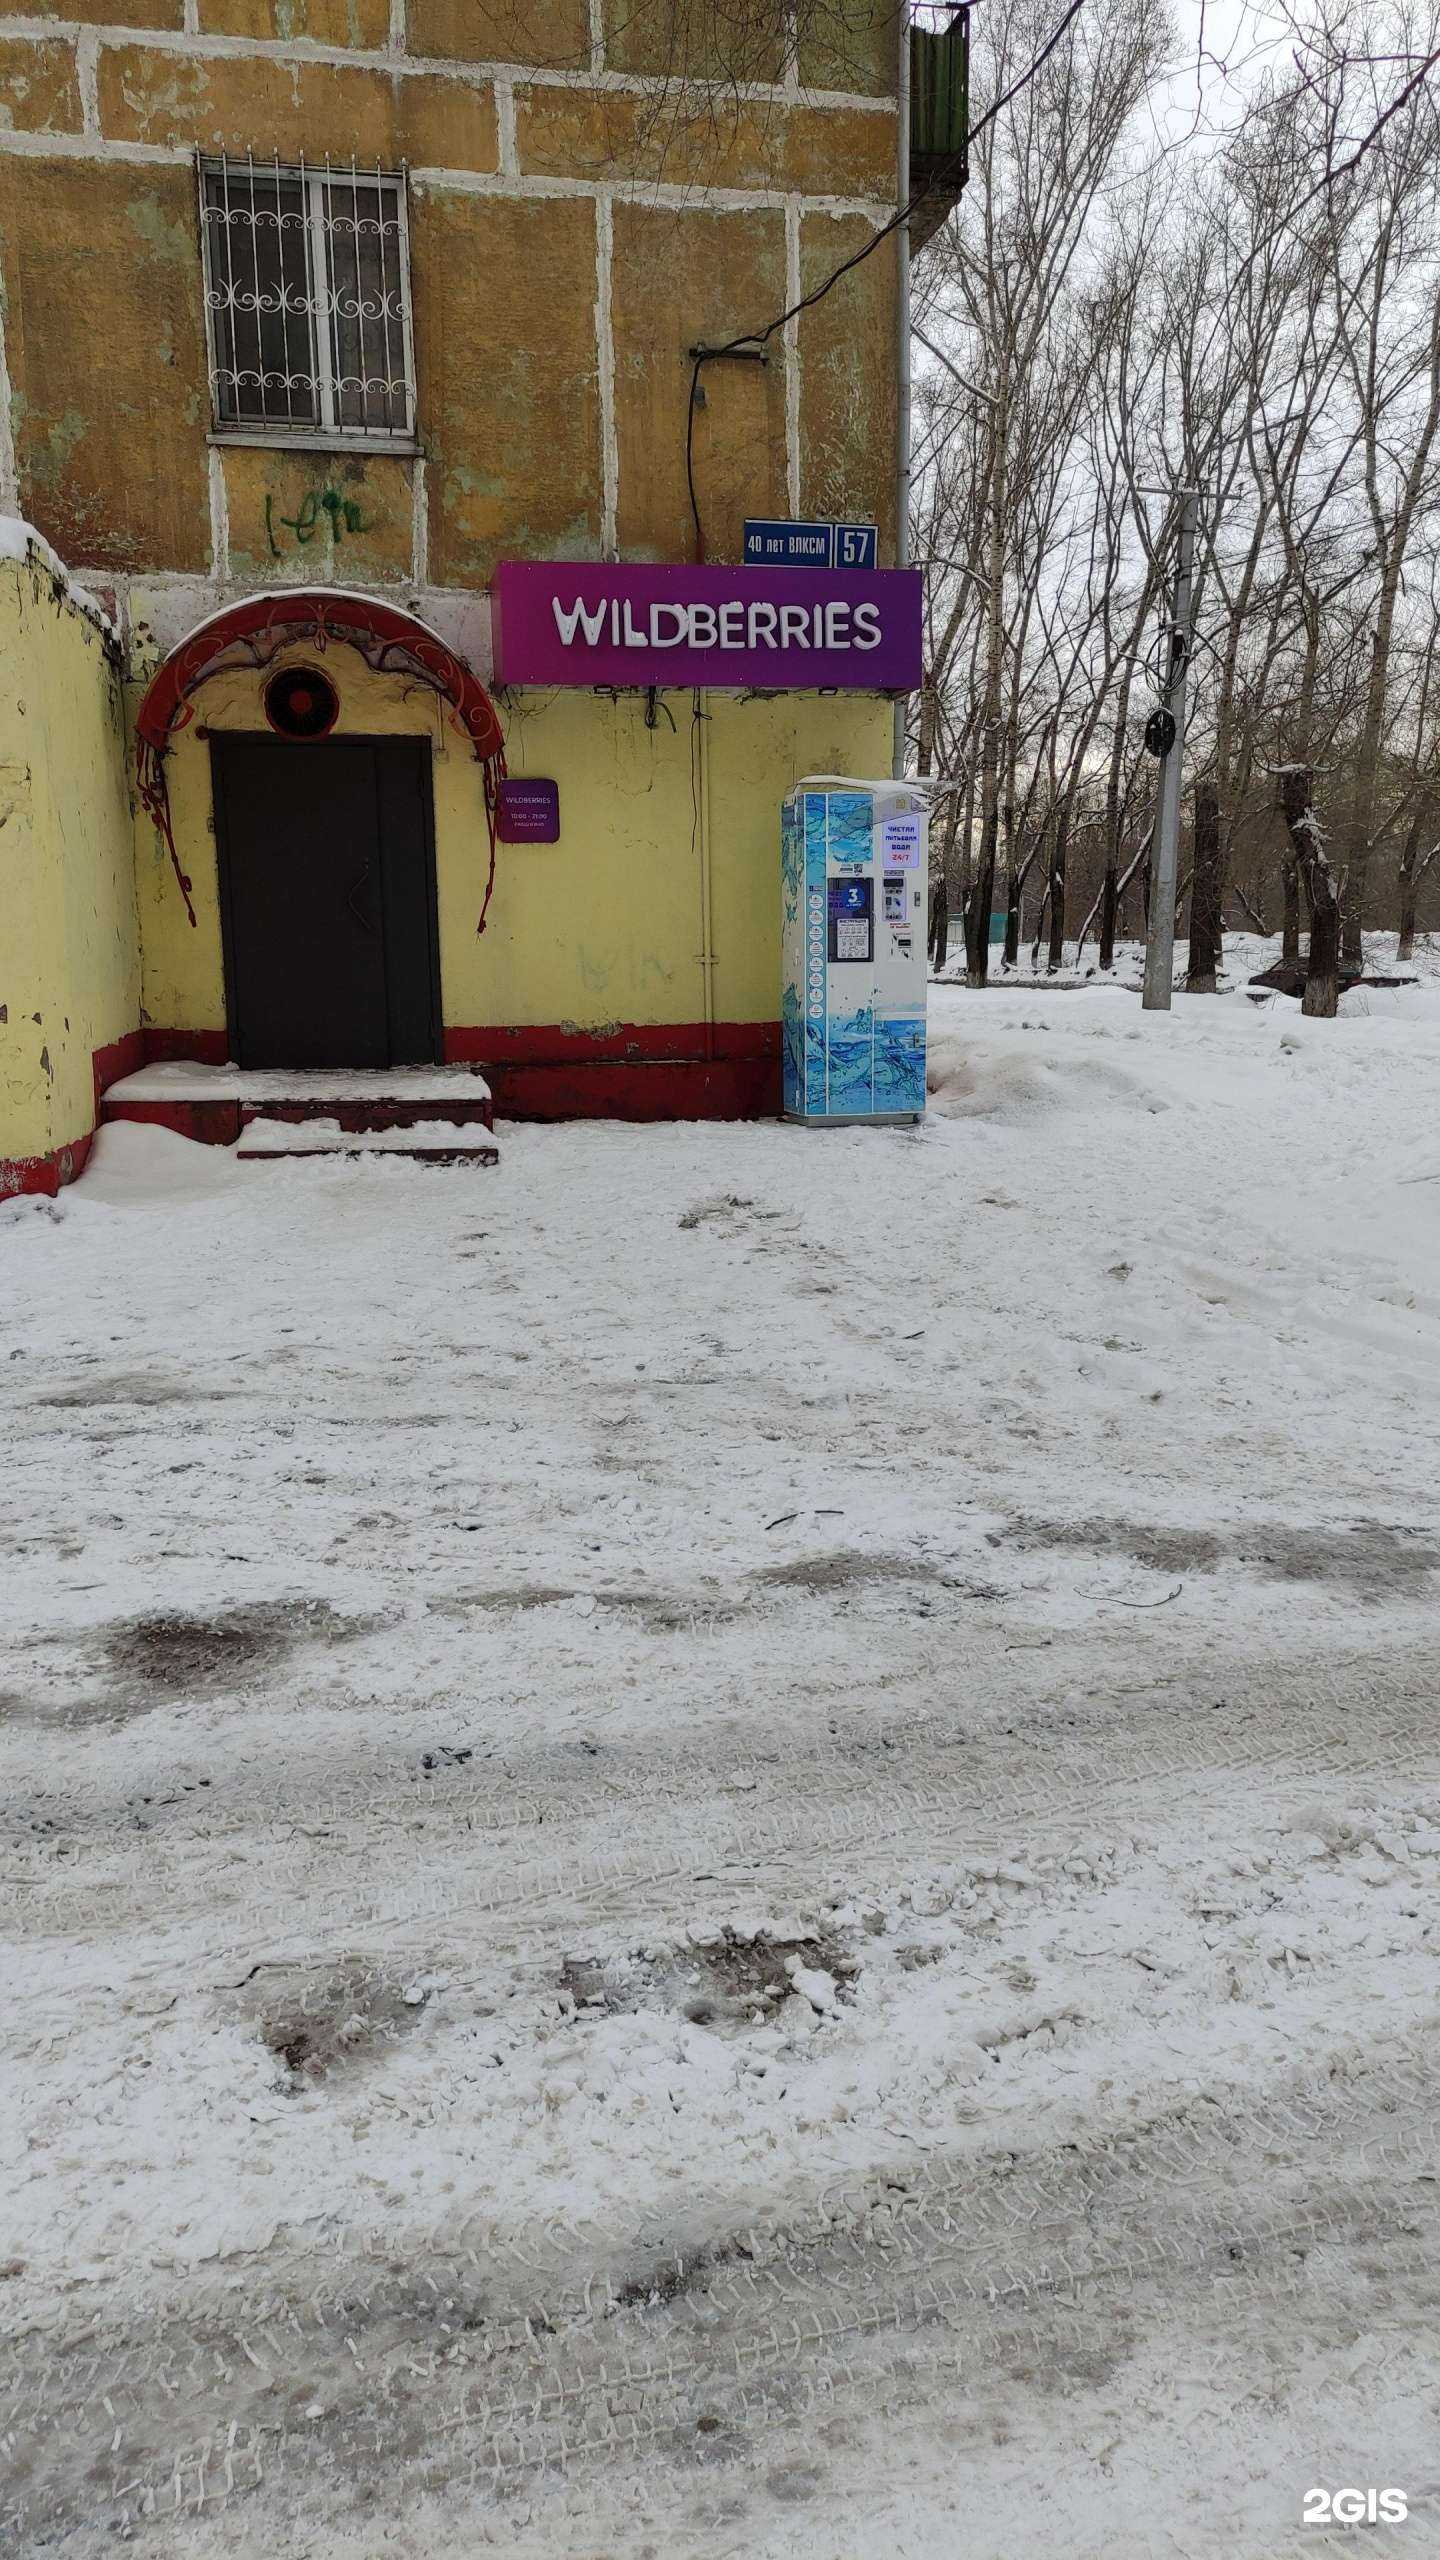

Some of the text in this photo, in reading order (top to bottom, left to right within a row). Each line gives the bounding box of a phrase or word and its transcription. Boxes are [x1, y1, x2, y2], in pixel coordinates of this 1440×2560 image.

[748, 535, 825, 554] 40 лет ВЛКСМ
[844, 532, 868, 563] 57
[552, 596, 882, 650] WILDBERRIES
[848, 888, 858, 903] 3
